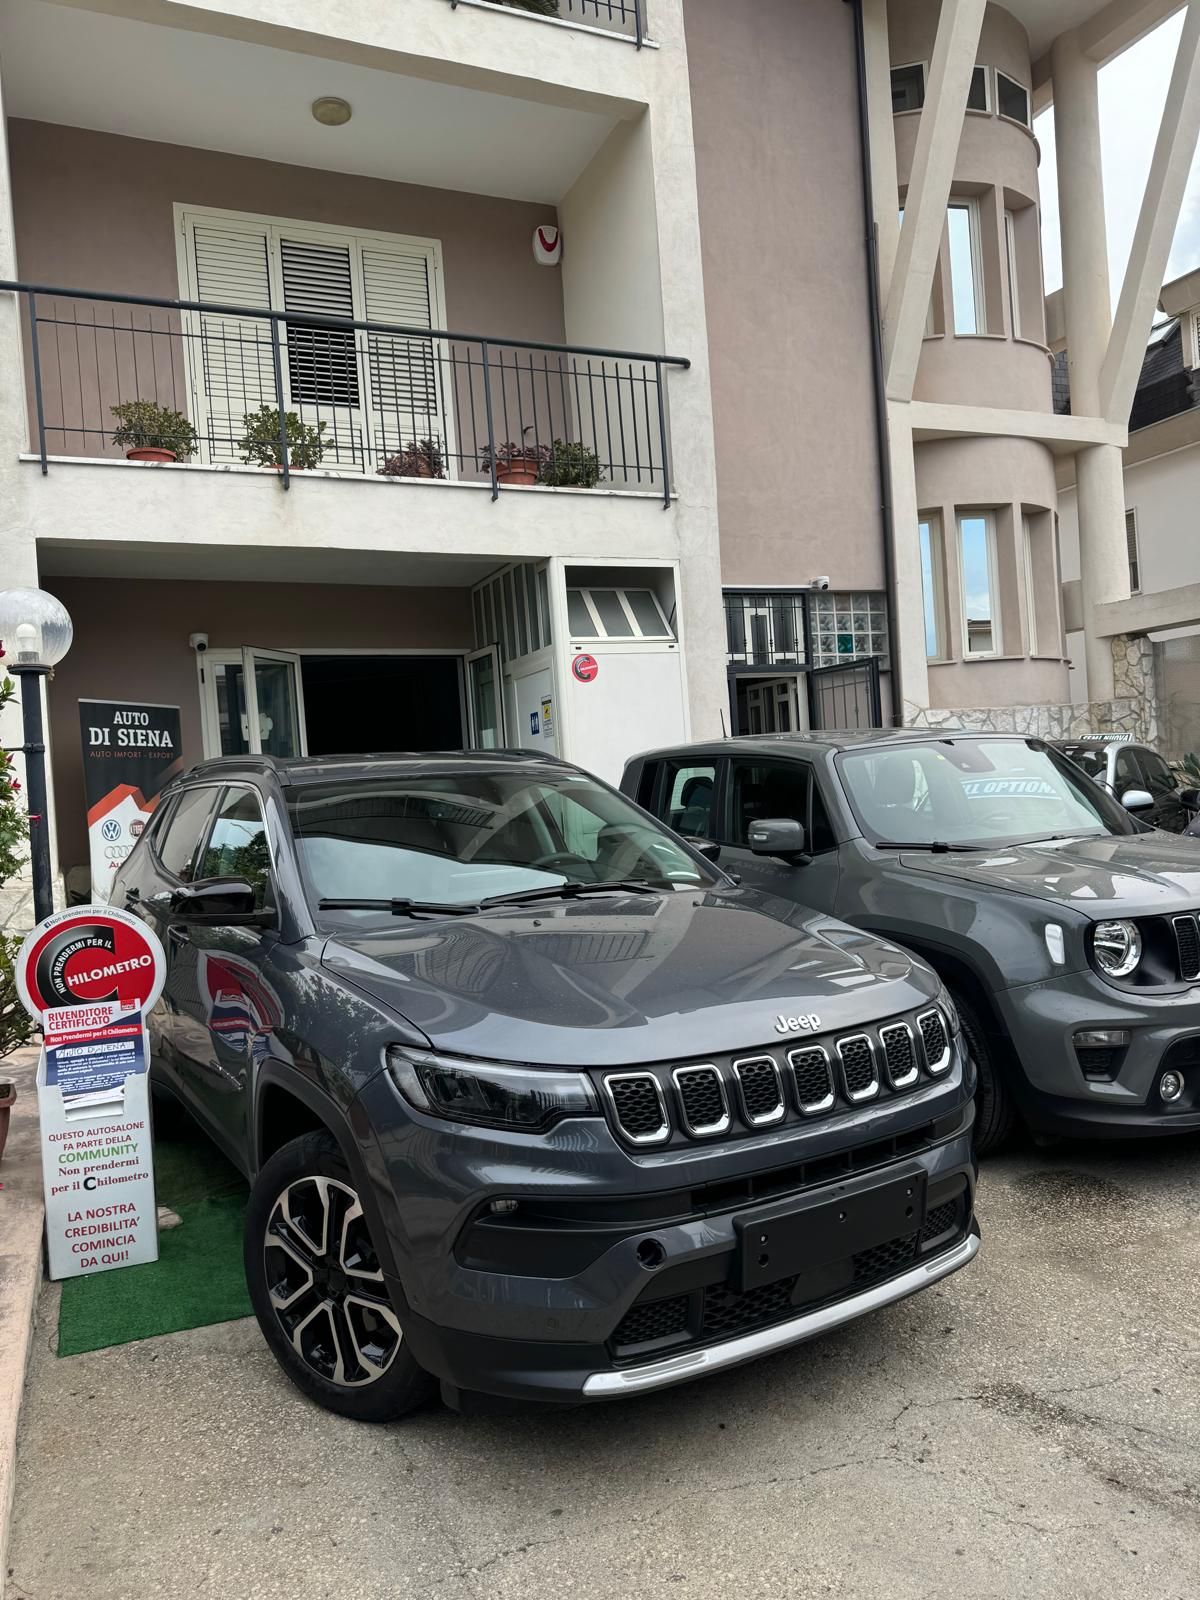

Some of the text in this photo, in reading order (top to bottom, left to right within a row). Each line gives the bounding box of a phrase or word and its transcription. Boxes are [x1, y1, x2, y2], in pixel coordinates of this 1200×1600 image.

[113, 711, 149, 726] AUTO
[89, 727, 174, 748] DI SIENA
[114, 751, 141, 759] IMPORT
[50, 917, 62, 926] Non
[62, 908, 92, 920] prendermi
[107, 910, 137, 926] Chilometro
[53, 938, 113, 994] NON PRENDERMI PER IL
[48, 1006, 114, 1022] RIVENDITORE
[48, 1015, 110, 1031] CERTIFICATO
[774, 1013, 821, 1034] Jeep
[63, 1032, 92, 1041] Prendermi
[92, 1030, 102, 1038] per
[107, 1027, 138, 1035] Chilometro
[48, 1121, 145, 1143] QUESTO AUTOSALONE
[63, 1134, 132, 1151] FA PARTE DELLA
[58, 1143, 138, 1164] COMMUNITY
[58, 1156, 140, 1177] Non prendermi
[51, 1172, 149, 1196] per il Chilometro
[67, 1202, 136, 1222] LA NOSTRA
[72, 1234, 136, 1253] COMINCIA
[80, 1250, 129, 1268] DA QUI!
